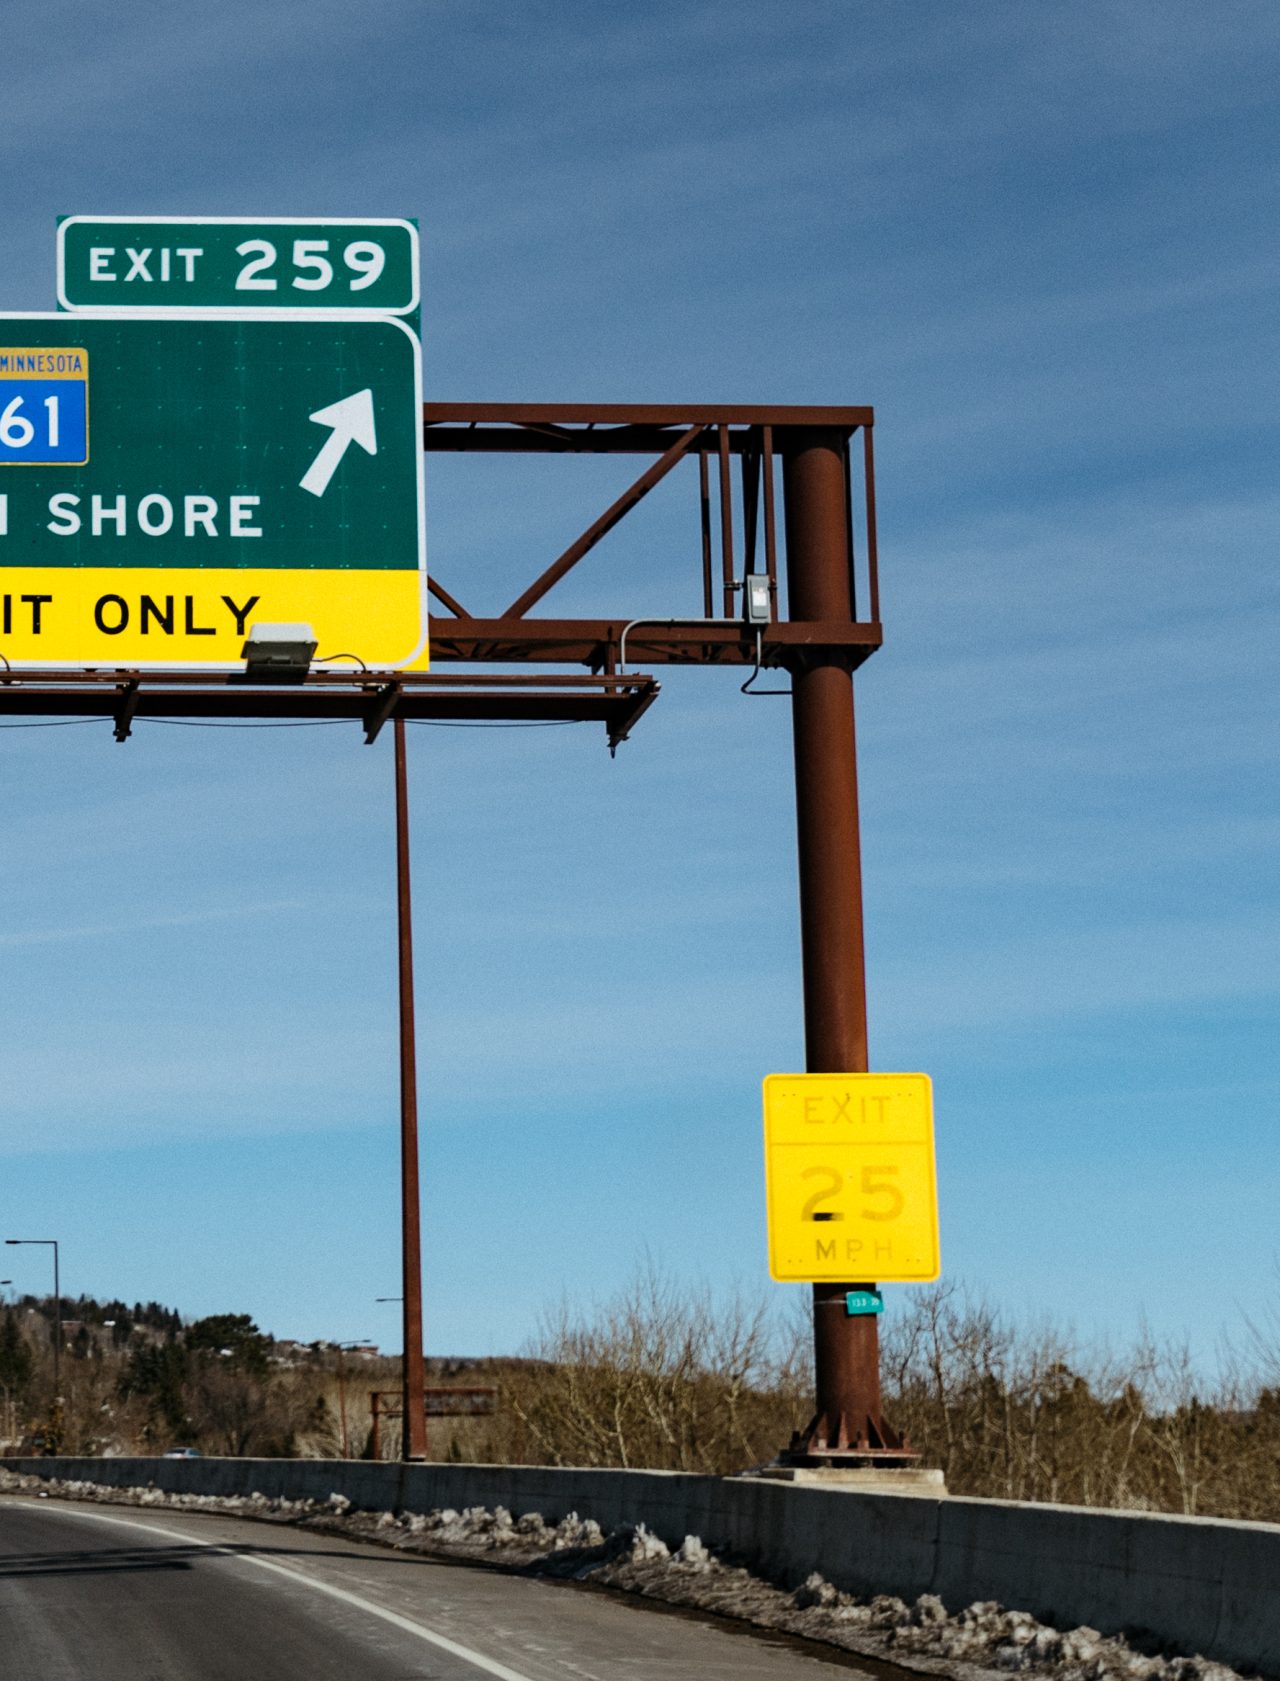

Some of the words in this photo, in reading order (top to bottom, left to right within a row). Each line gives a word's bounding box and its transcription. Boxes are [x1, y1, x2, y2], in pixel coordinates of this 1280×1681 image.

[91, 247, 203, 282] EXIT
[235, 239, 385, 291] 259
[0, 354, 82, 373] MINNESOTA
[47, 493, 263, 537] SHORE
[94, 593, 261, 636] ONLY
[804, 1096, 892, 1124] EXIT
[800, 1166, 906, 1222] 25
[816, 1239, 893, 1261] MPH
